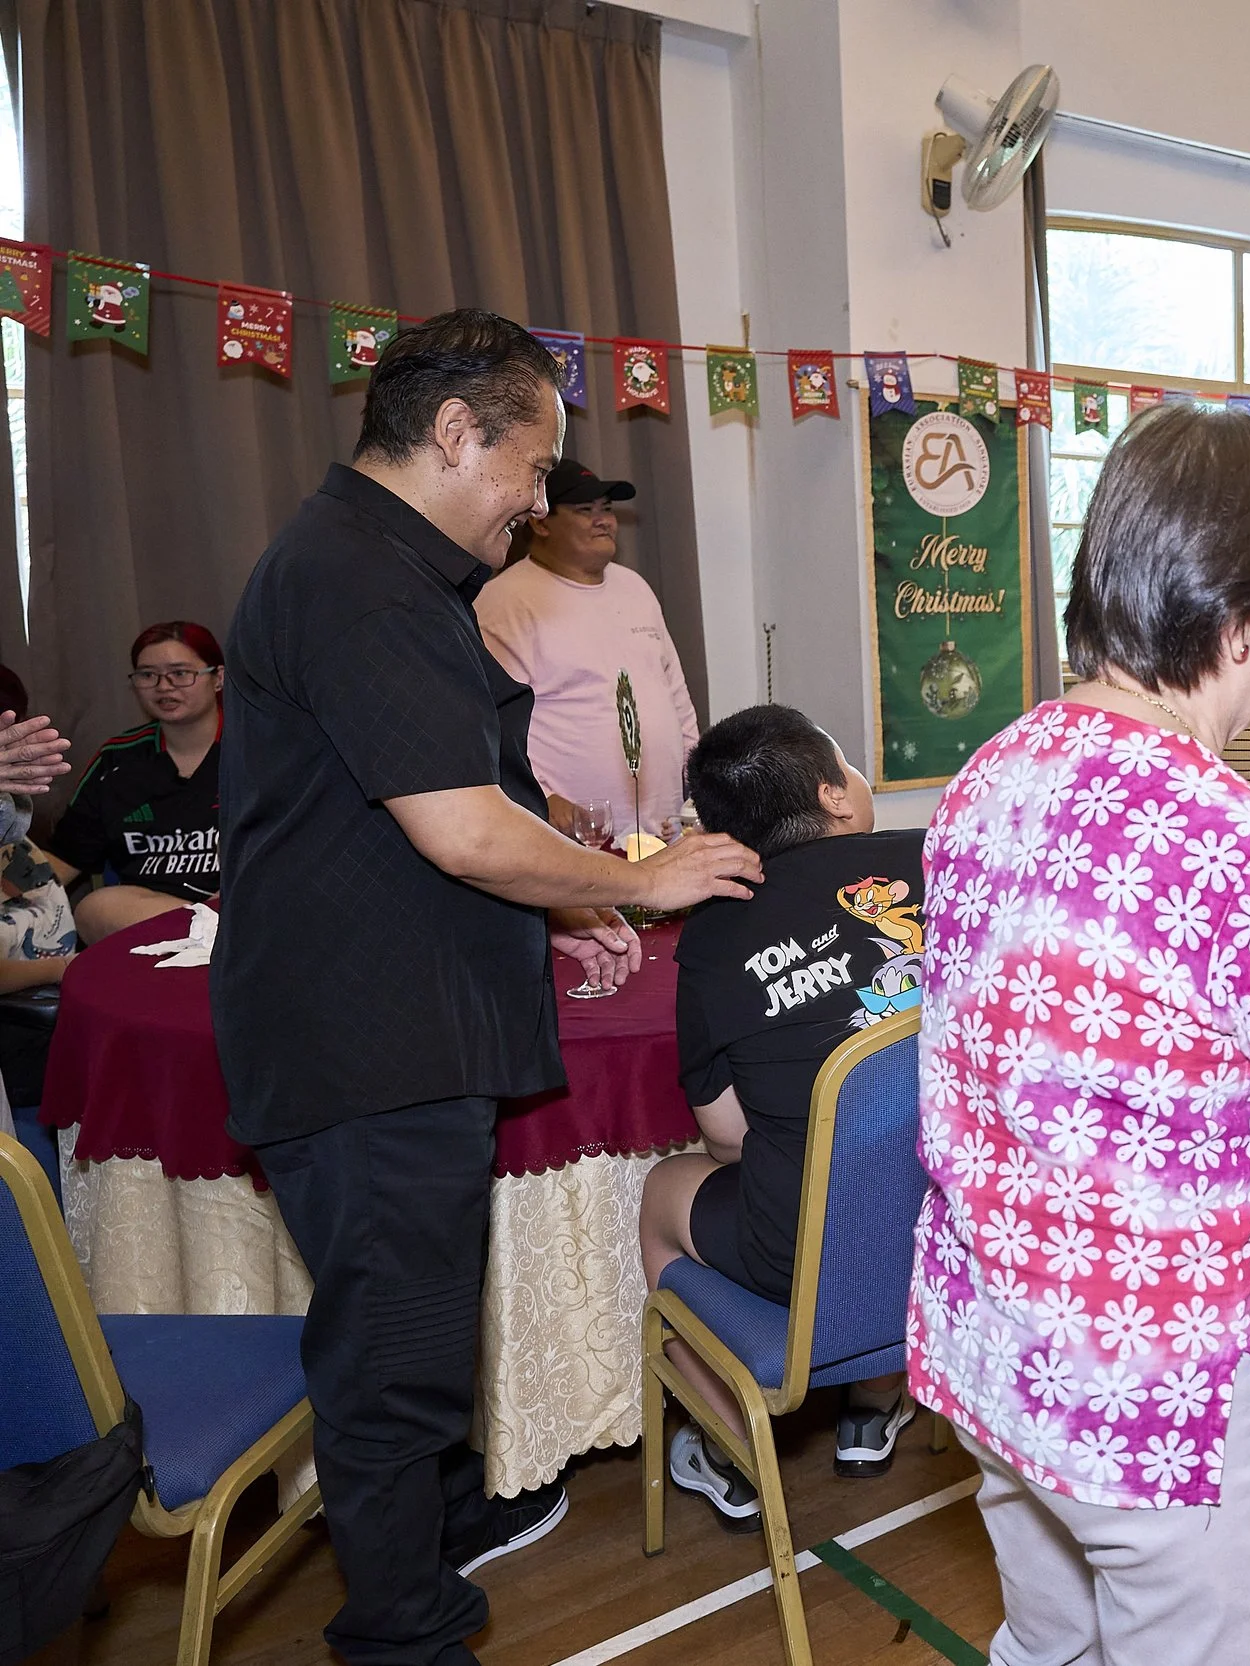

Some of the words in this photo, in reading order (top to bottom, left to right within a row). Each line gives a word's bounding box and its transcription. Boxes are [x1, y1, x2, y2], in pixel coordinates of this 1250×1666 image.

[0, 246, 26, 258] ERRY
[0, 255, 37, 269] STMAS!
[231, 327, 281, 342] CHRISTMAS!
[241, 321, 271, 332] MERRY
[915, 414, 971, 431] ASSOCIATION
[904, 440, 917, 492] EURASIAN
[910, 533, 988, 573] Merry
[895, 580, 1006, 619] Christmas!
[123, 826, 220, 855] Emirat
[139, 856, 165, 876] FLY
[744, 936, 807, 982] TOM
[811, 923, 839, 952] and
[764, 952, 853, 1018] JERRY
